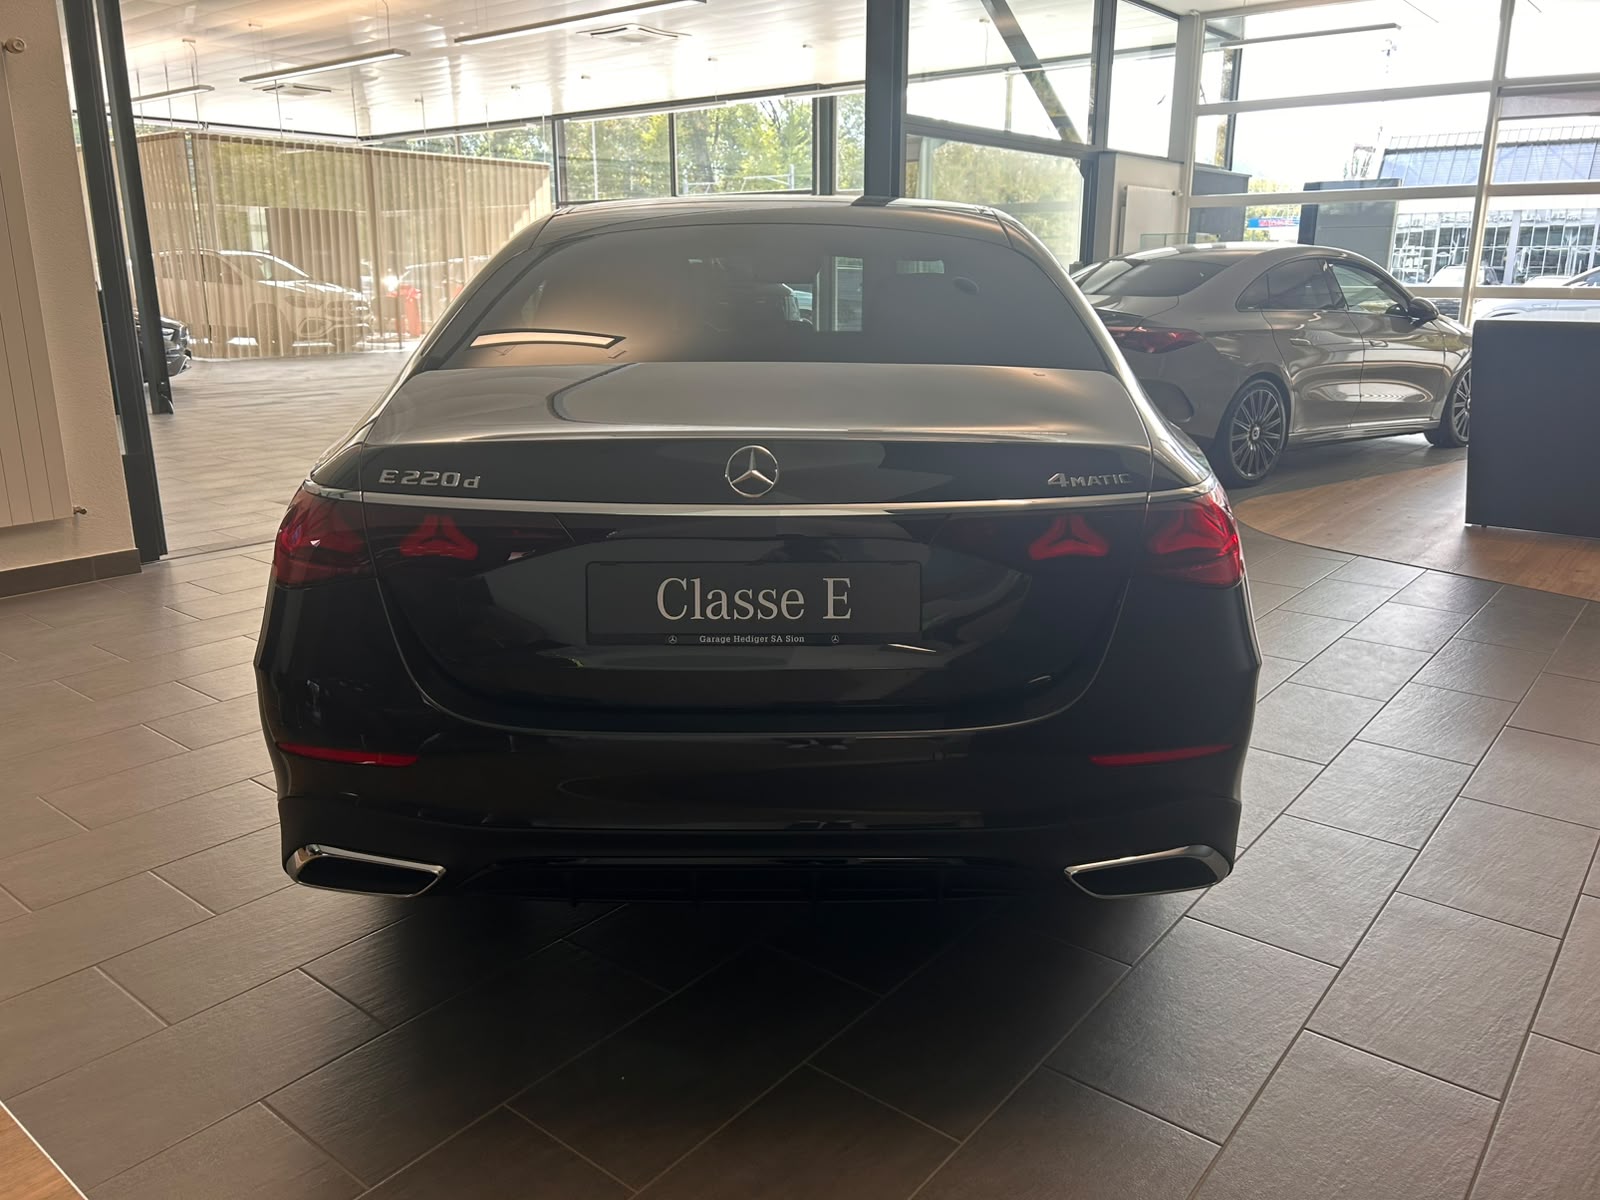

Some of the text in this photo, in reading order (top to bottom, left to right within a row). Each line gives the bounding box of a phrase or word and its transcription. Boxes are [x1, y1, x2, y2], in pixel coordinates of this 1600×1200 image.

[1047, 472, 1132, 487] 4MATIC
[657, 577, 852, 620] Classe E
[699, 635, 805, 644] Garage Hediger SA Sion
